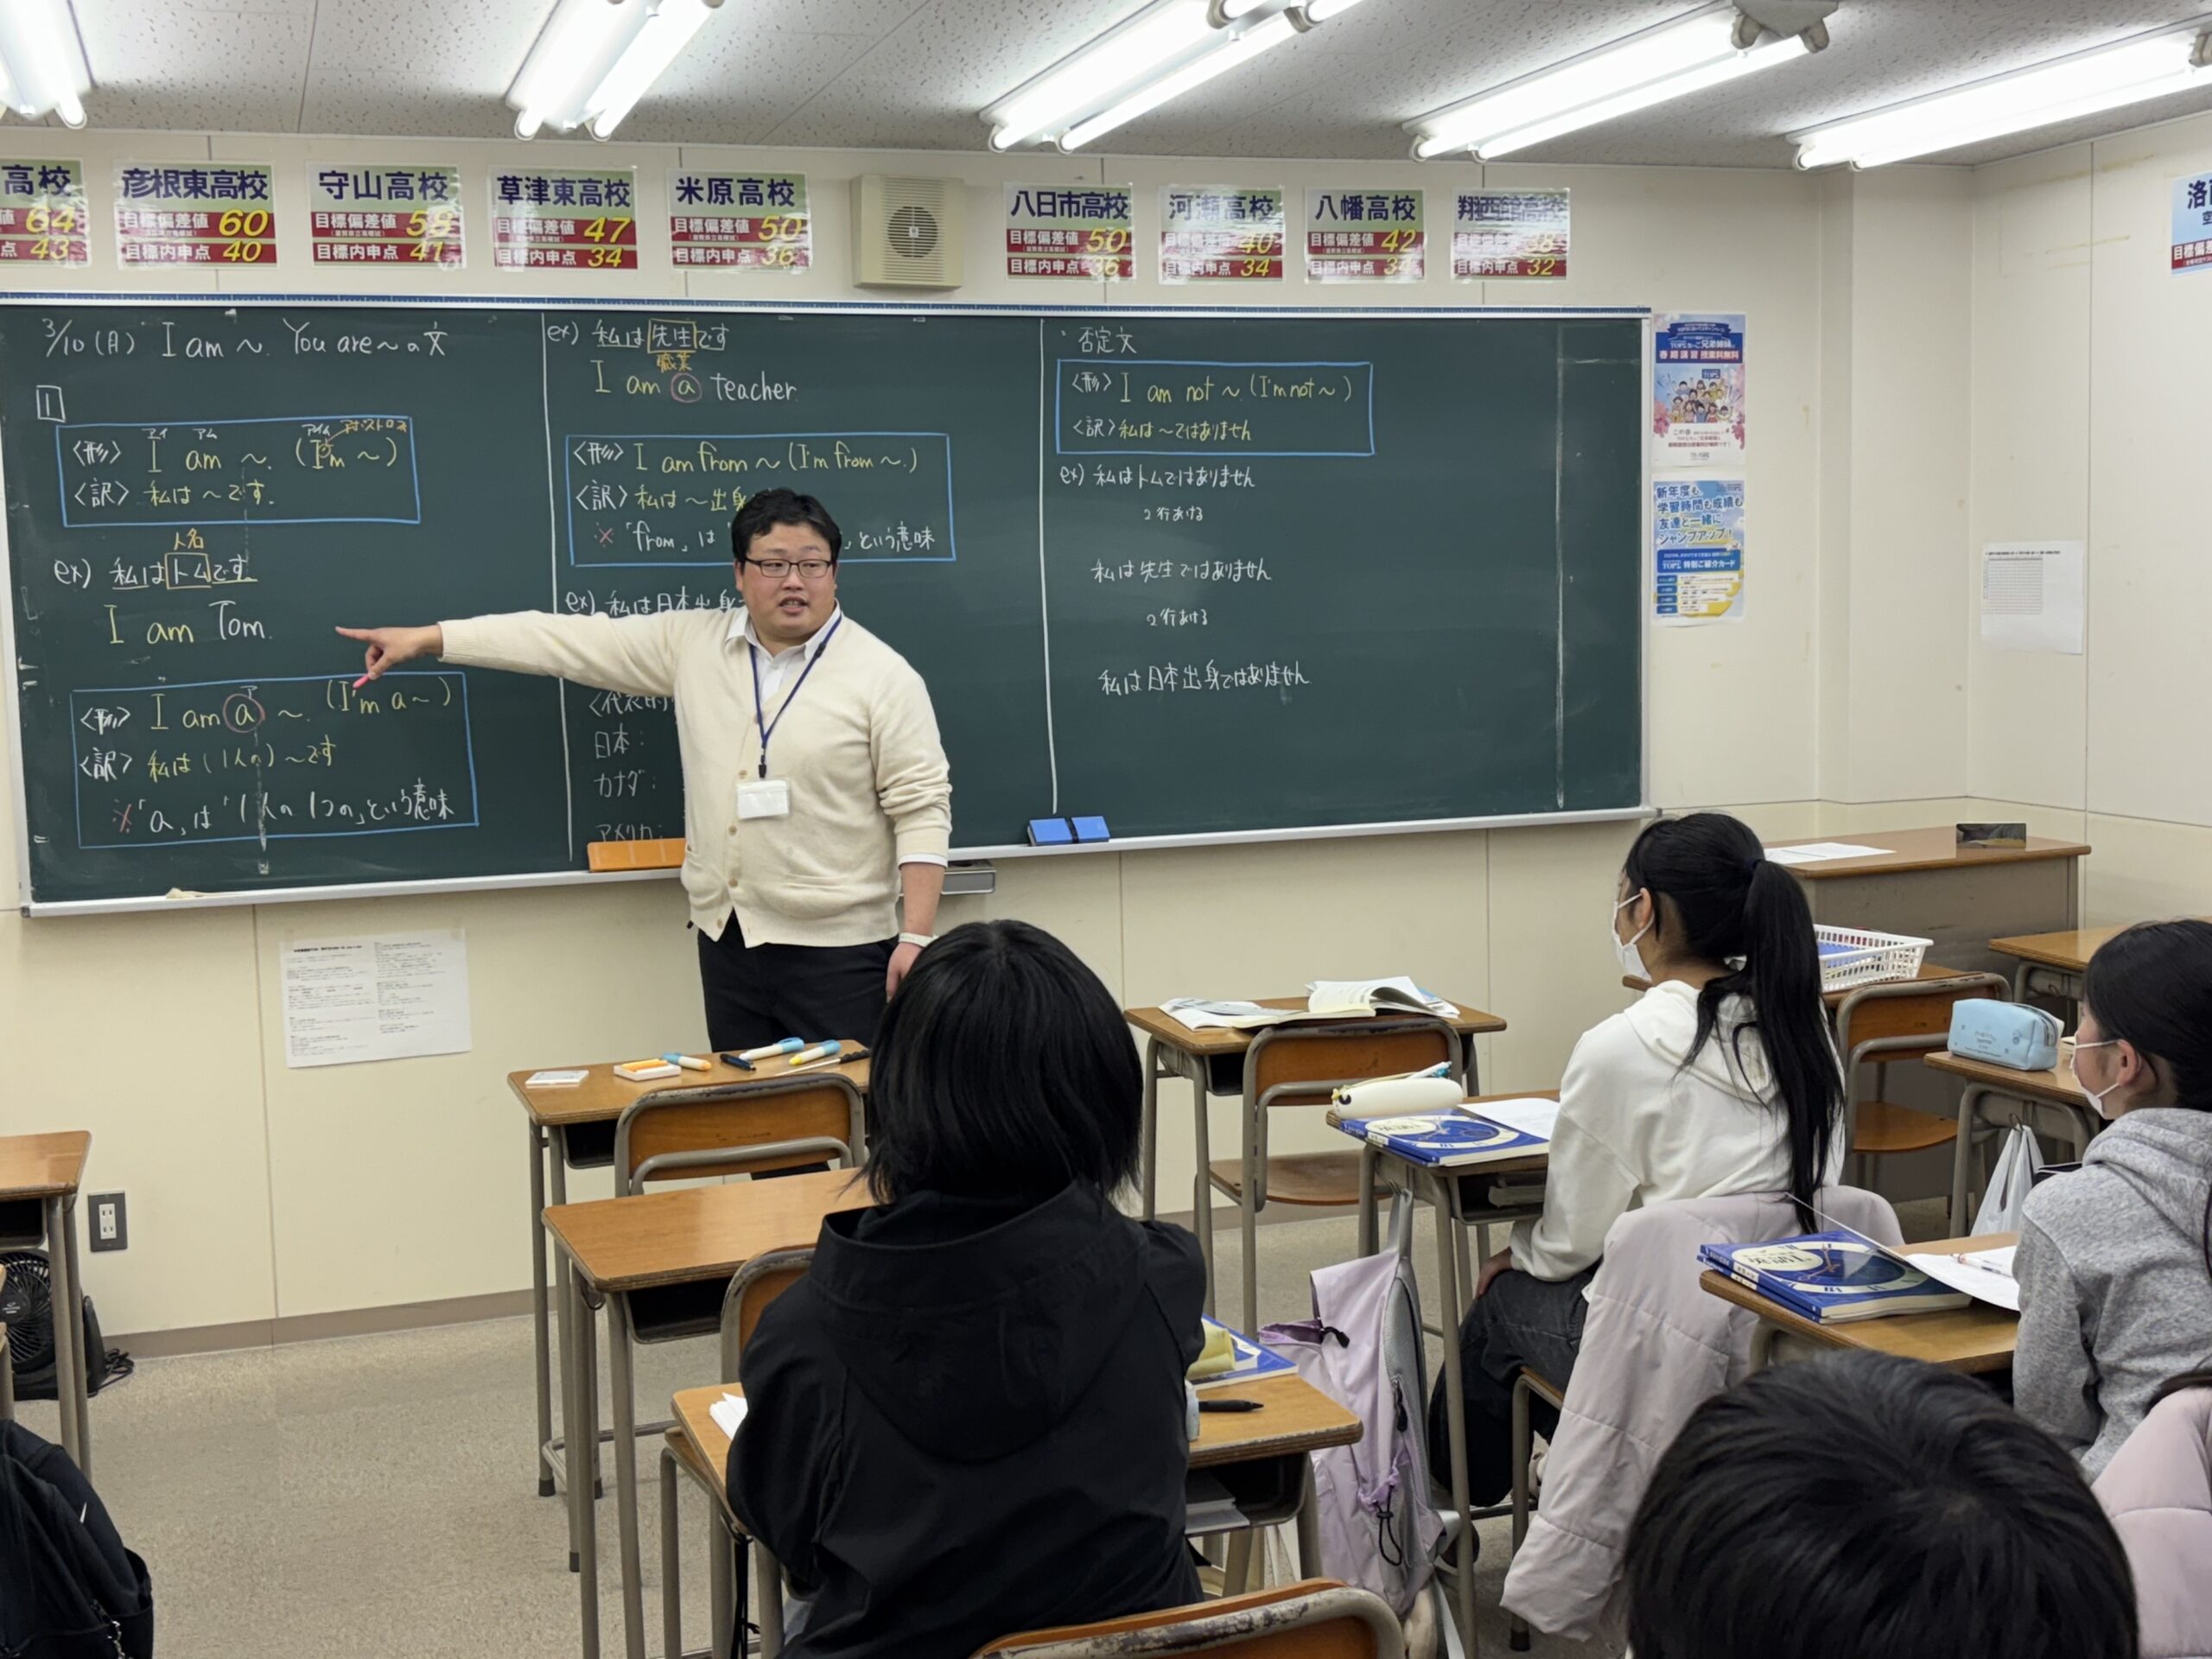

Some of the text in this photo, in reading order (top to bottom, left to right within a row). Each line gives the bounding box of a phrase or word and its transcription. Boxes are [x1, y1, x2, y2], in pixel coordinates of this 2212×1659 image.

[122, 168, 269, 200] 彦根東高校
[319, 171, 448, 201] 守山高校
[497, 175, 631, 207] 草津東高校
[676, 176, 796, 207] 米原高校
[2187, 179, 2212, 209] 洛
[1011, 189, 1128, 220] 八日市高校
[1315, 194, 1416, 221] 八幡高校
[26, 207, 76, 234] 64
[219, 208, 269, 237] 60
[316, 213, 397, 229] 目標偏差値
[497, 216, 631, 243] 目標偏差値 47
[675, 214, 804, 241] 目標偏差値 50
[30, 235, 69, 260] 43
[126, 240, 263, 263] 目標内申点 40
[317, 245, 398, 260] 目標内申点
[1010, 227, 1127, 252] 目標偏差値 50
[1311, 229, 1417, 253] 目標偏差値 42
[498, 246, 623, 268] 目標内申点 34
[676, 248, 752, 264] 目標内申点
[1010, 259, 1079, 274] 目標内申点
[1241, 257, 1270, 276] 34
[1311, 260, 1375, 275] 目標内申点
[1458, 257, 1555, 276] 目標内申点 32
[162, 322, 176, 357] I
[186, 337, 224, 358] am
[283, 318, 327, 354] You
[337, 336, 372, 354] are
[547, 321, 579, 345] ex)
[590, 359, 612, 393] I
[626, 375, 660, 394] am
[677, 380, 696, 395] a
[1120, 372, 1131, 403] I
[1147, 385, 1172, 403] am
[1186, 375, 1215, 402] not
[1290, 377, 1315, 398] not
[147, 436, 162, 473] I
[186, 450, 221, 470] am
[633, 442, 648, 471] I
[662, 455, 694, 474] am
[698, 441, 747, 473] from
[835, 441, 874, 470] from
[1060, 463, 1084, 486] ex)
[54, 558, 91, 588] ex)
[565, 590, 595, 616] ex)
[104, 605, 124, 644] I
[147, 622, 194, 644] am
[150, 693, 168, 729] I
[183, 709, 220, 729] am
[235, 703, 255, 726] a
[391, 691, 407, 710] a
